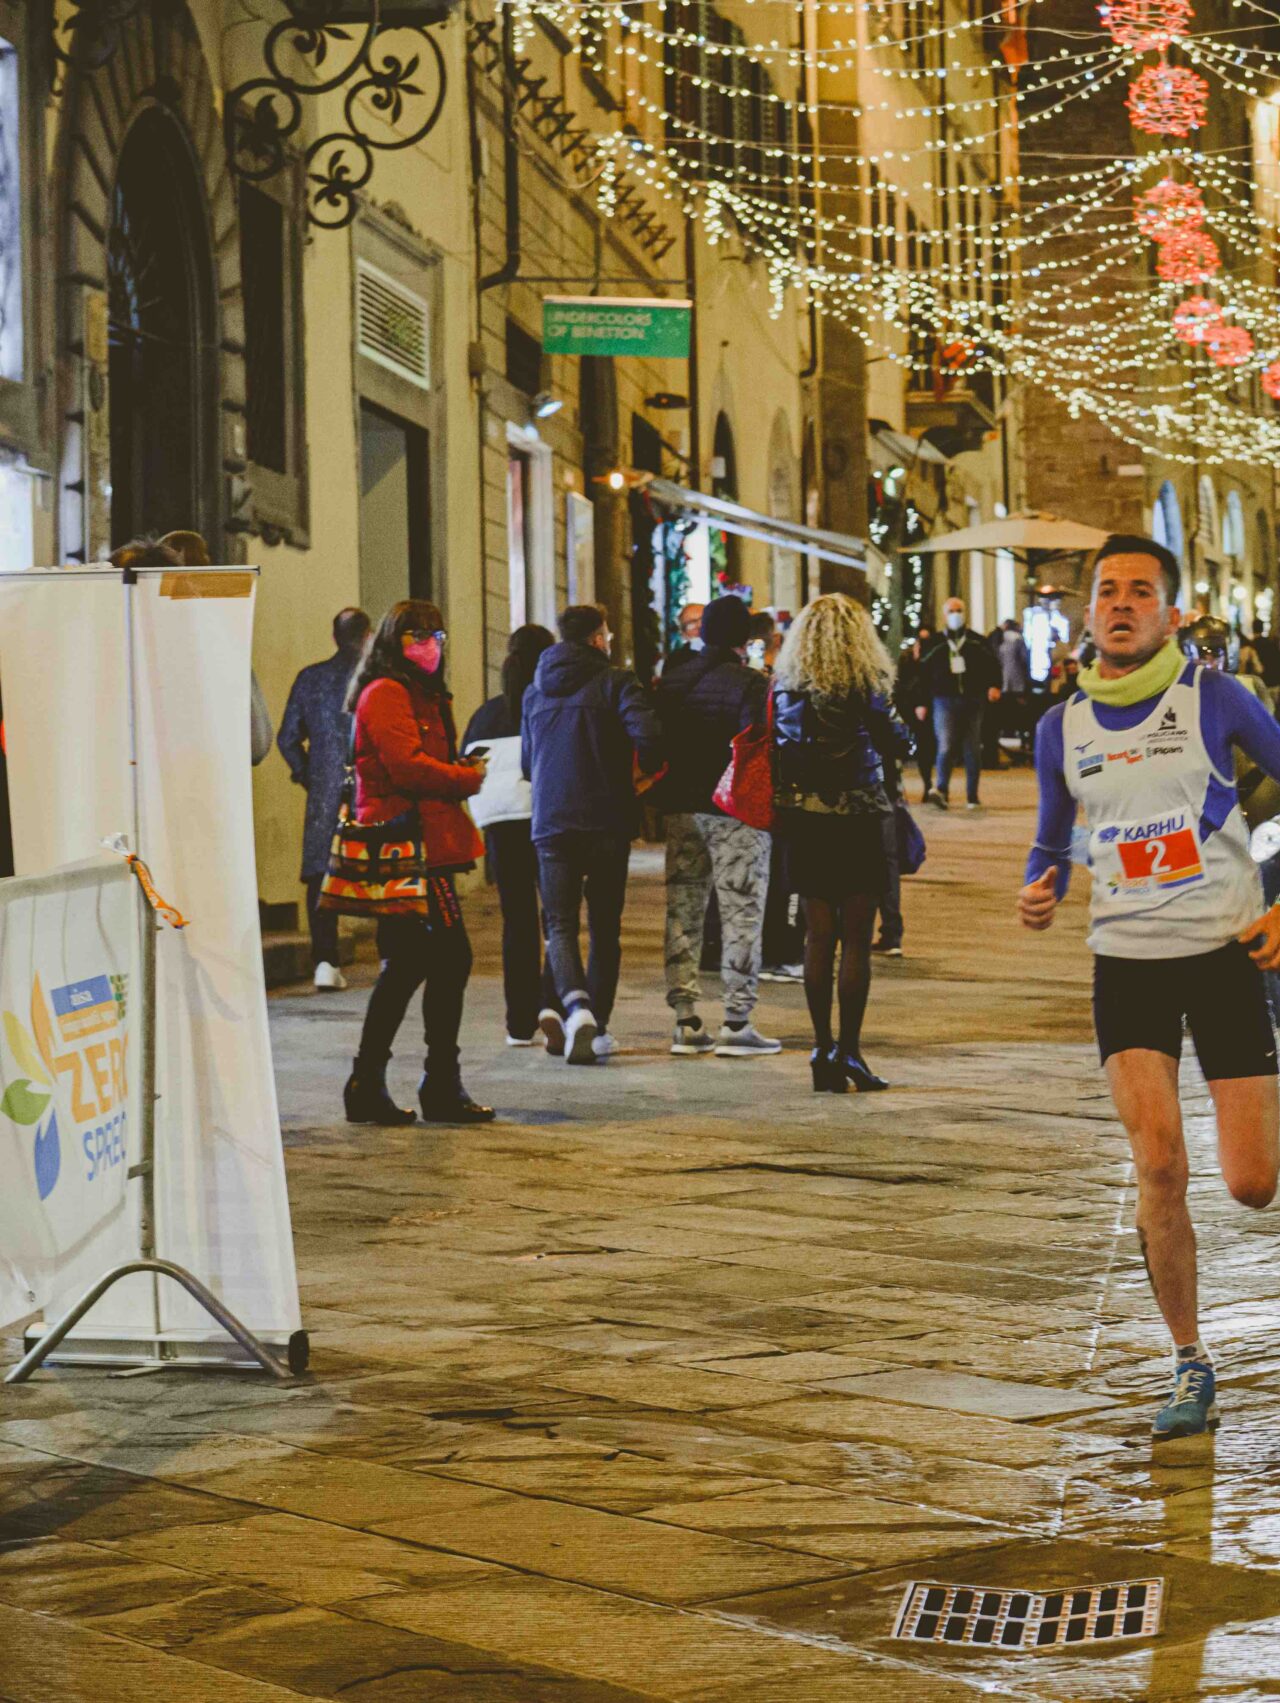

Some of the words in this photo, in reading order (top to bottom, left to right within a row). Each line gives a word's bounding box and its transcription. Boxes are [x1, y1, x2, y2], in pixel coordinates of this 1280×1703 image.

[549, 324, 568, 338] OF
[1124, 814, 1185, 842] KARHU
[1145, 839, 1171, 875] 2
